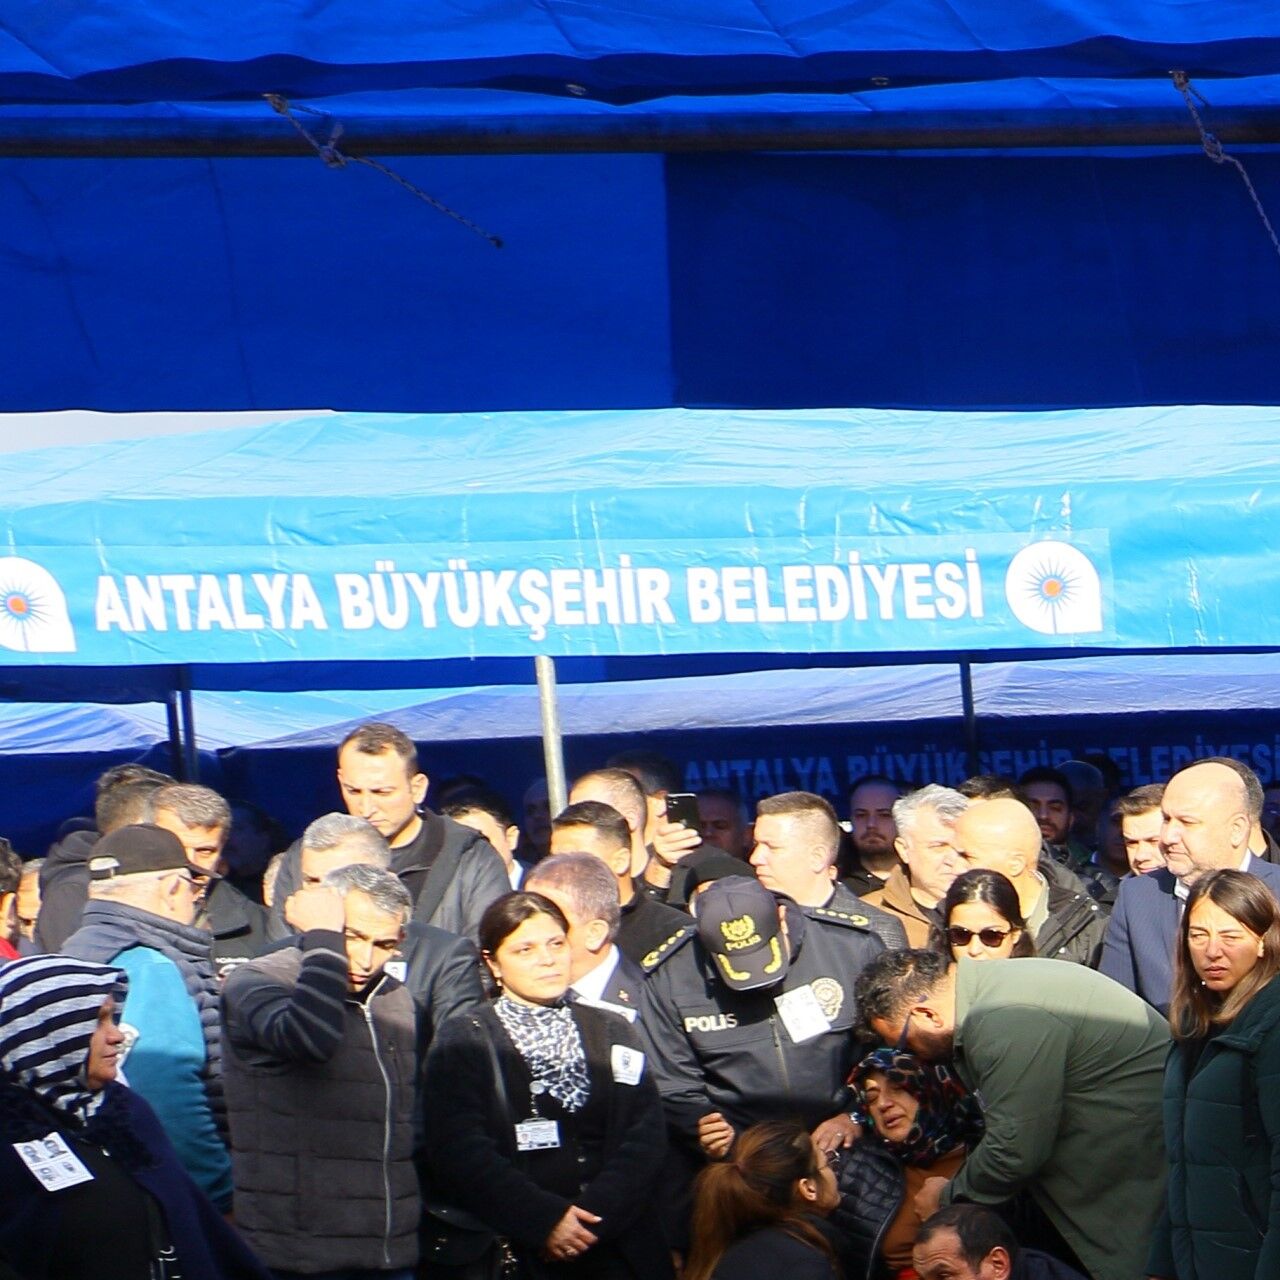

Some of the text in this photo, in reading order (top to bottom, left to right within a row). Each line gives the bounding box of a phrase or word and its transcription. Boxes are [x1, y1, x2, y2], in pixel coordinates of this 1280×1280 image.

[97, 547, 985, 641] ANTALYA BÜYÜKŞEHİR BELEDİYESİ
